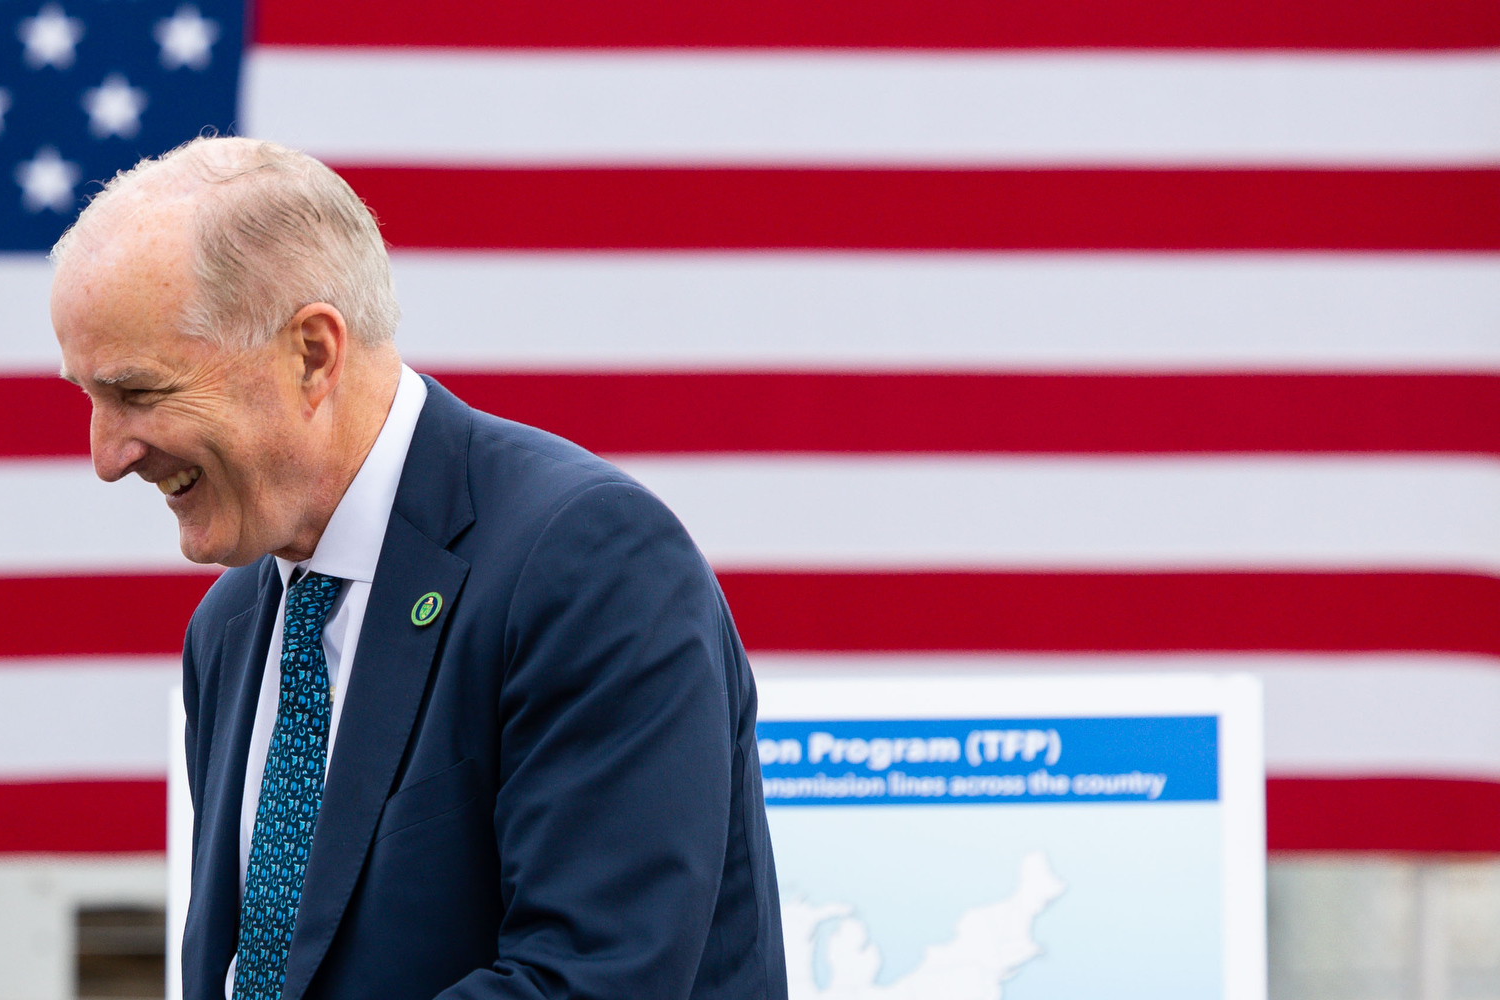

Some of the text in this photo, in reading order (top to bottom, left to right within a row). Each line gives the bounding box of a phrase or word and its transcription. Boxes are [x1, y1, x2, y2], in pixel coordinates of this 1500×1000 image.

[808, 732, 961, 771] Program
[965, 729, 1062, 767] (TFP)
[887, 770, 947, 797] lines
[948, 775, 1026, 797] across
[1027, 768, 1070, 795] the
[1071, 771, 1167, 799] country
